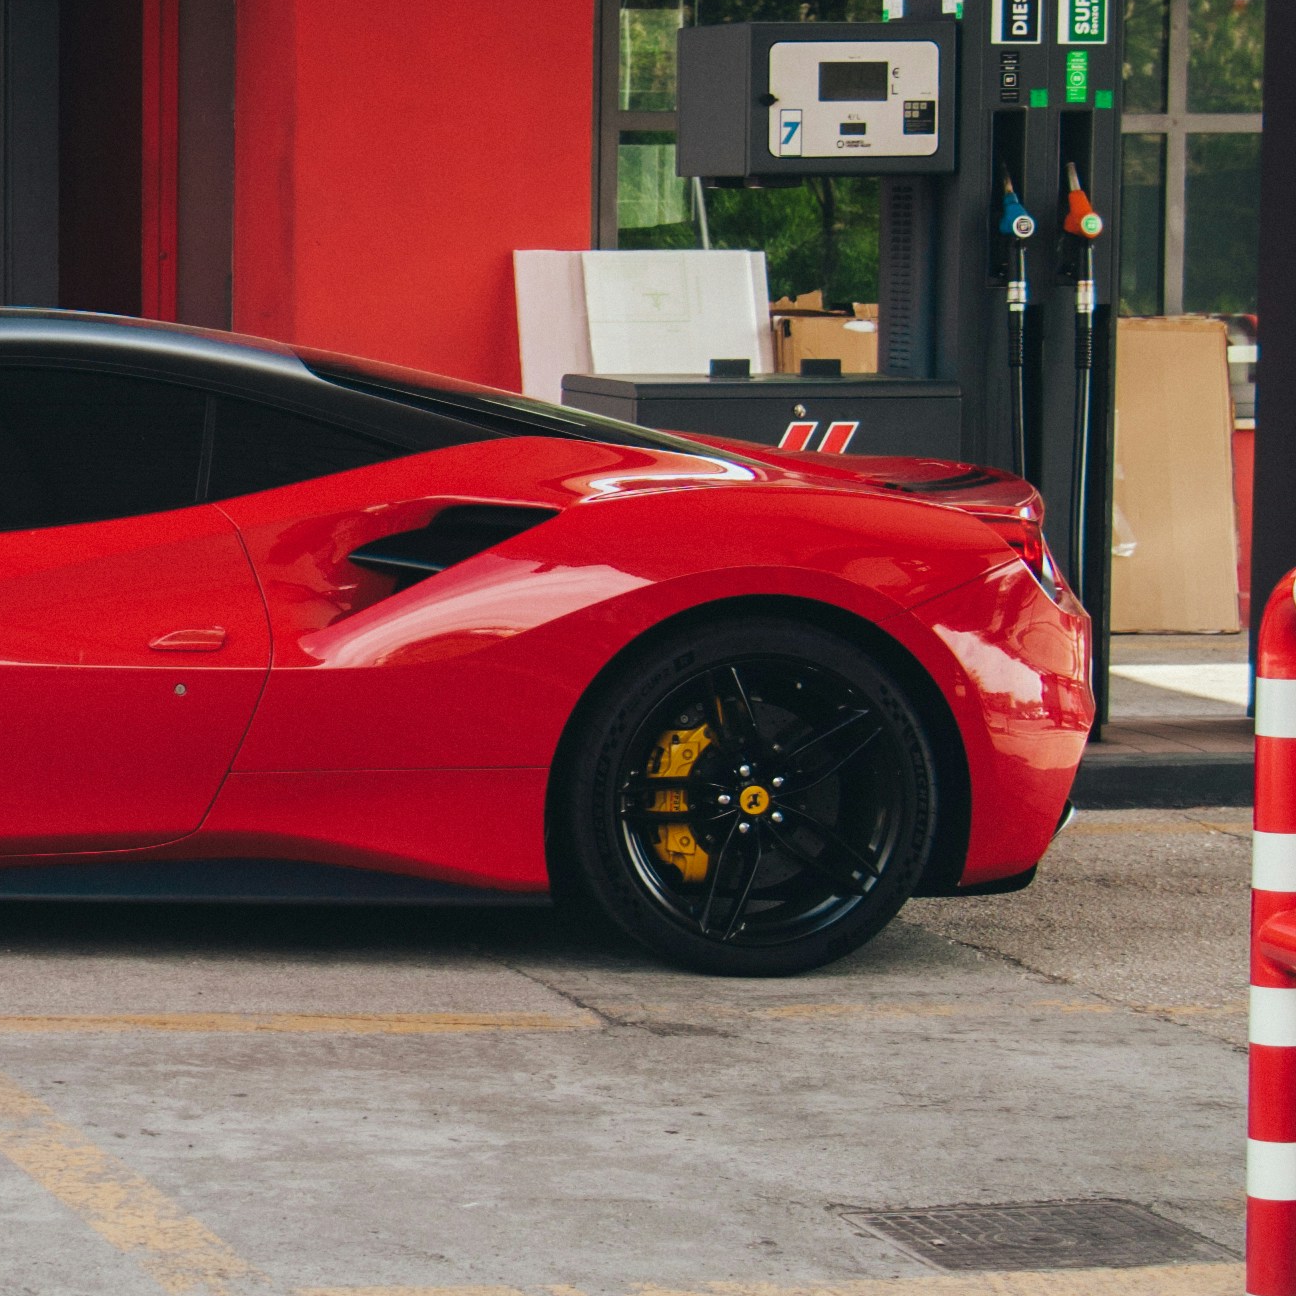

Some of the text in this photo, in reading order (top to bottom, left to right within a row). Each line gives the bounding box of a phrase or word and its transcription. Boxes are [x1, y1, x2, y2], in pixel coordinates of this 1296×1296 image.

[892, 67, 900, 79] €
[891, 84, 899, 95] L
[782, 121, 801, 145] 7
